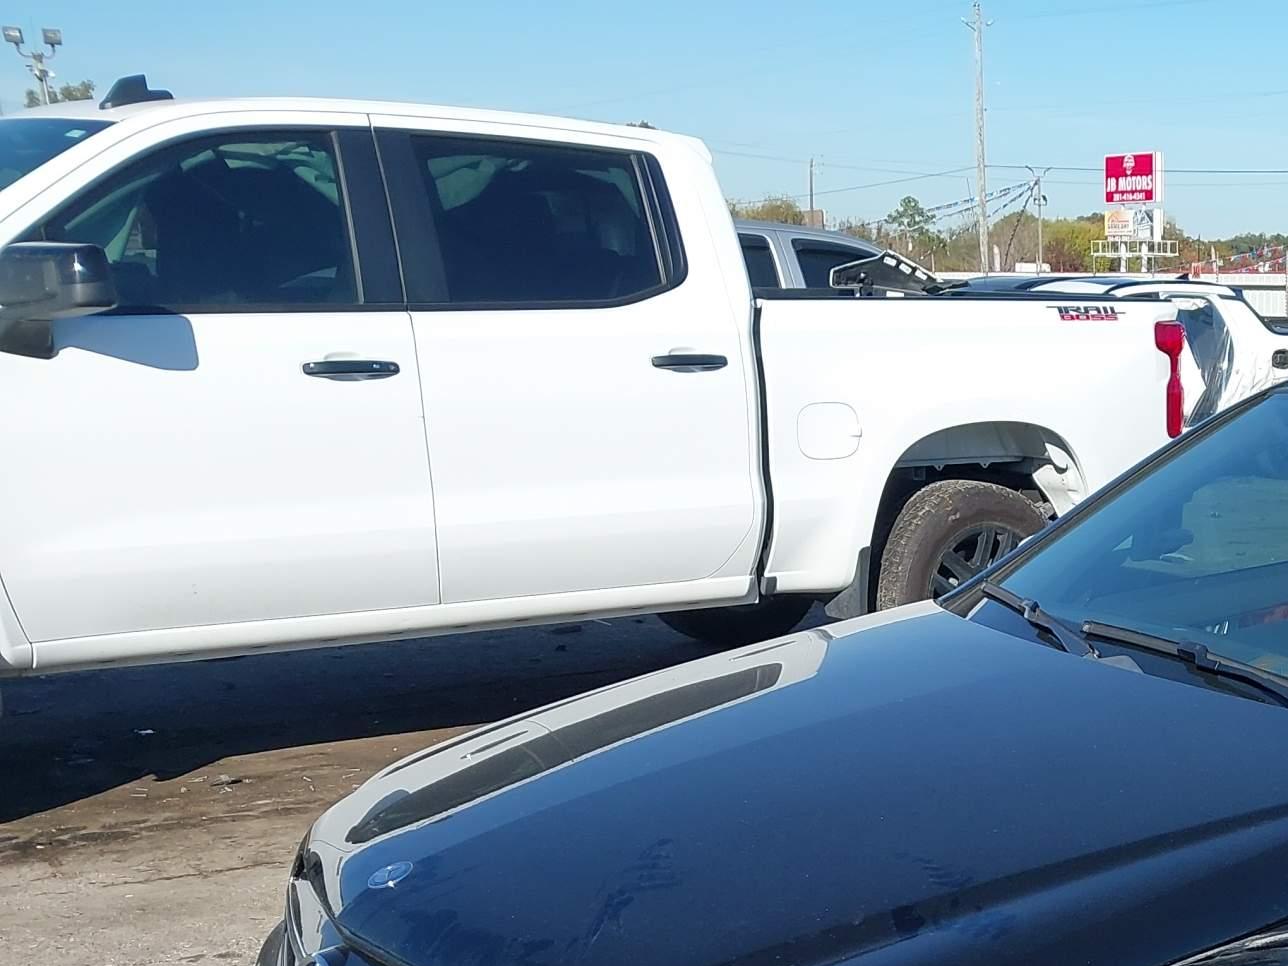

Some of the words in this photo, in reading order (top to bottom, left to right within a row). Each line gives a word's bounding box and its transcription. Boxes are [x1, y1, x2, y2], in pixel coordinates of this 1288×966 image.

[1107, 176, 1117, 192] JB
[1118, 175, 1153, 191] MOTORS
[1046, 306, 1126, 314] TRAIL
